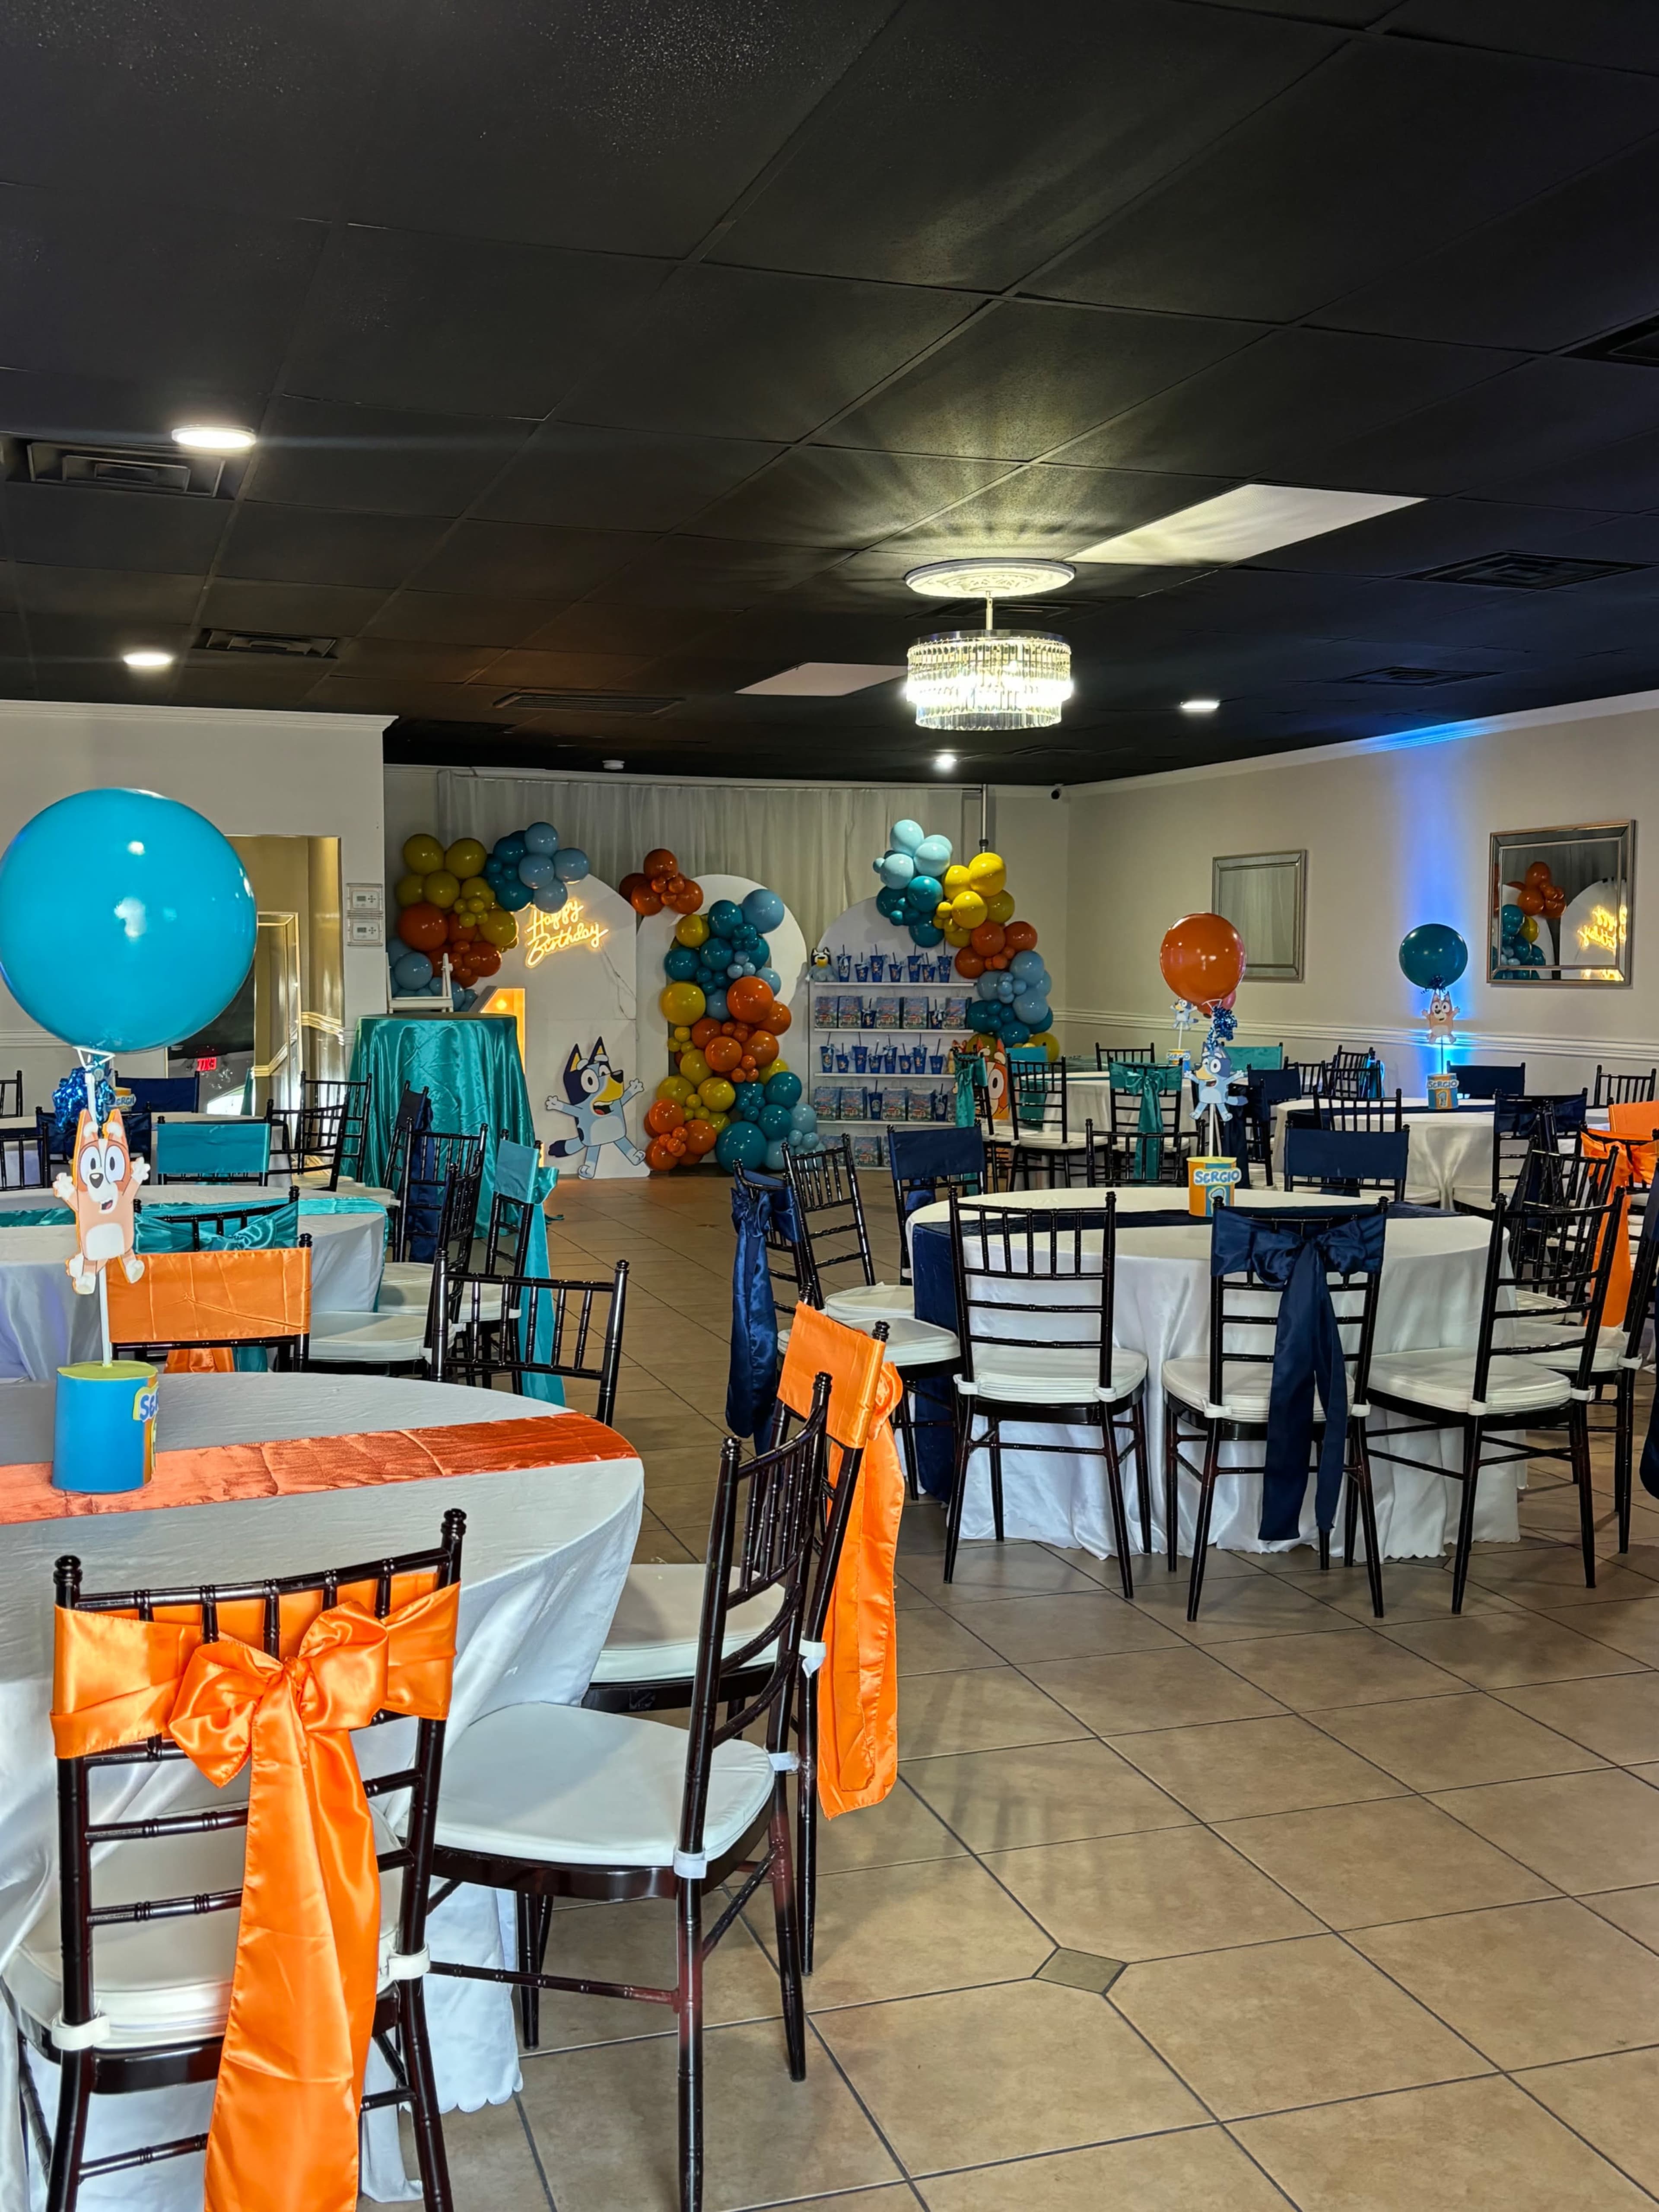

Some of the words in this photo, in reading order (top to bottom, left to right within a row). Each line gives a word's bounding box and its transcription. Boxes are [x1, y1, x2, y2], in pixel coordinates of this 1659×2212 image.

[526, 901, 584, 940] Happy
[527, 922, 609, 966] Birthday
[1427, 1080, 1458, 1088] SERGIO
[1195, 1170, 1240, 1183] SERGIO
